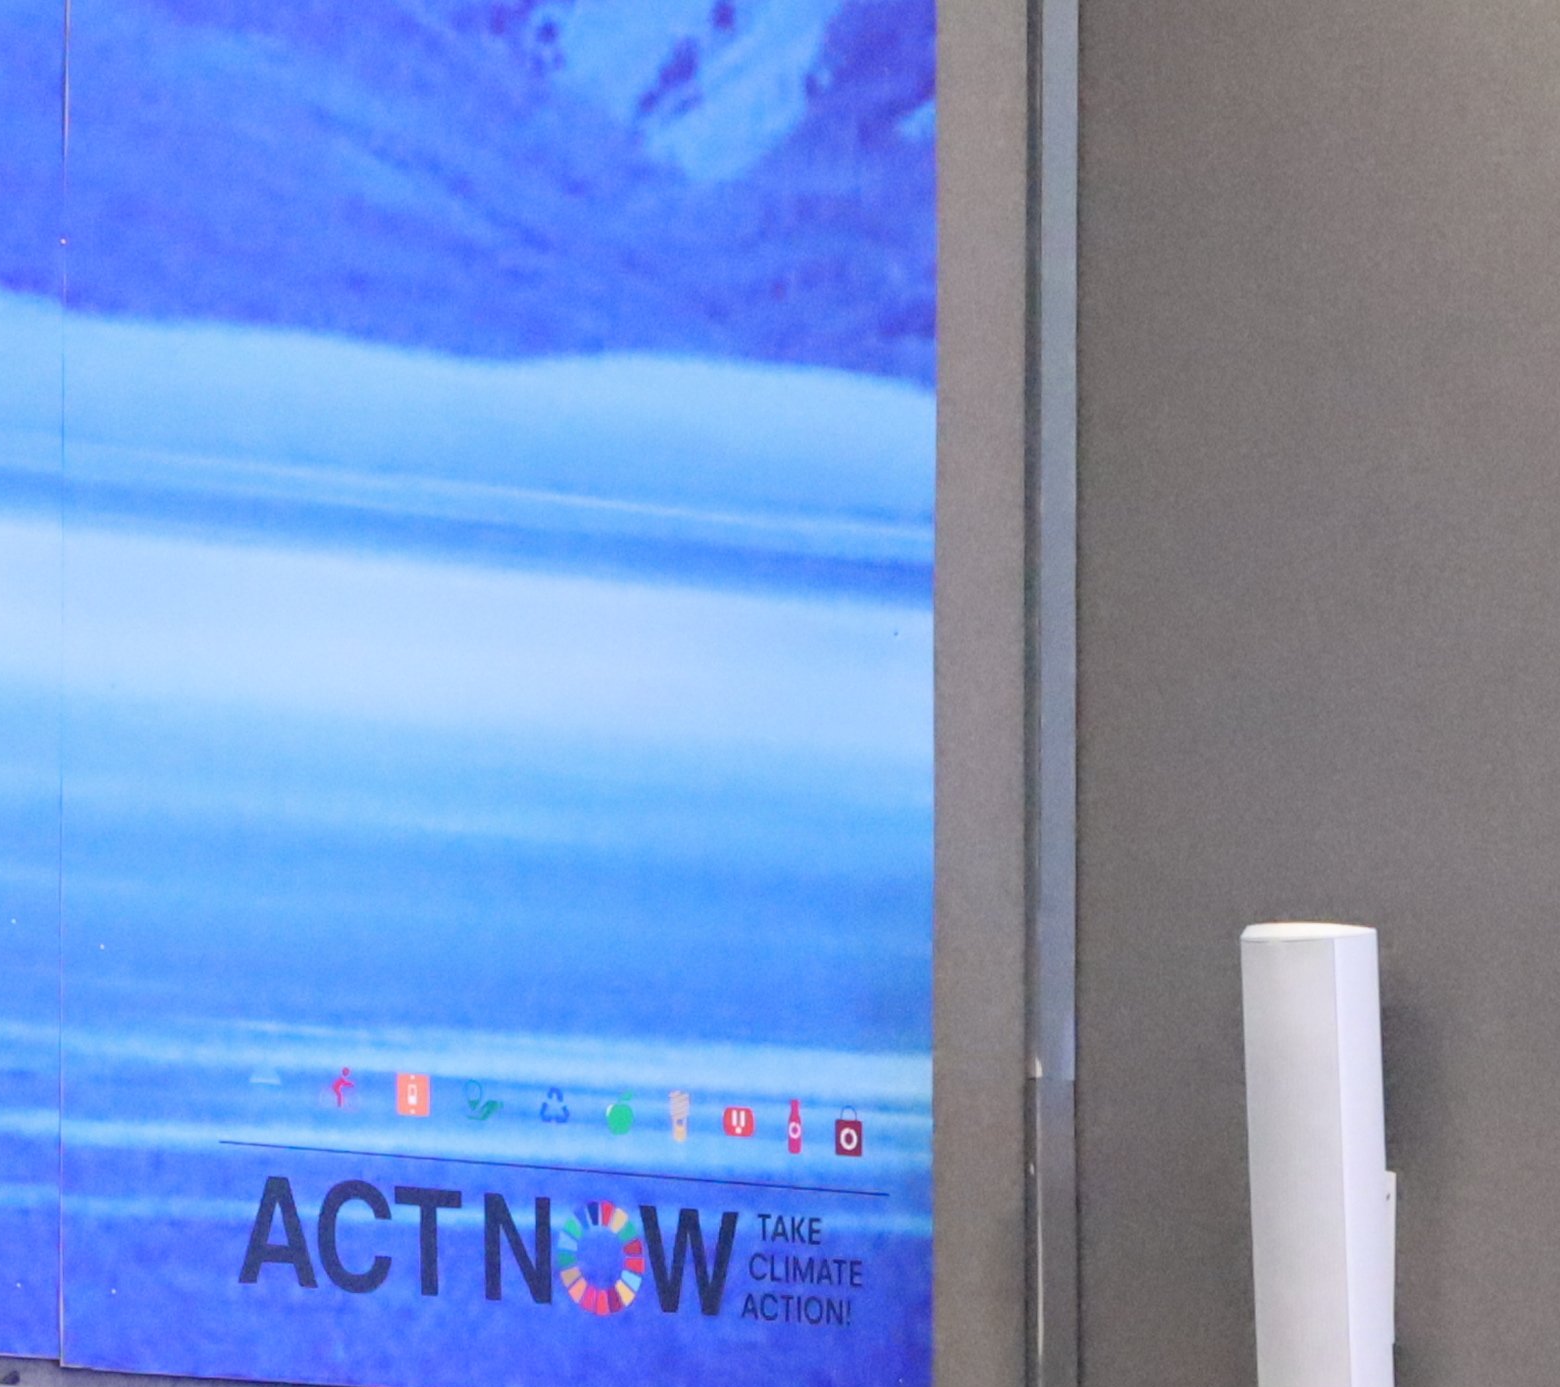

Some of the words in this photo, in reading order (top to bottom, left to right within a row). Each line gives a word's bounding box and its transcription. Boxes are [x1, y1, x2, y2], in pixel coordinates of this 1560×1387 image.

[238, 1175, 462, 1296] ACT
[757, 1212, 822, 1246] TAKE
[748, 1251, 863, 1288] CLIMATE
[740, 1292, 853, 1327] ACTION!
